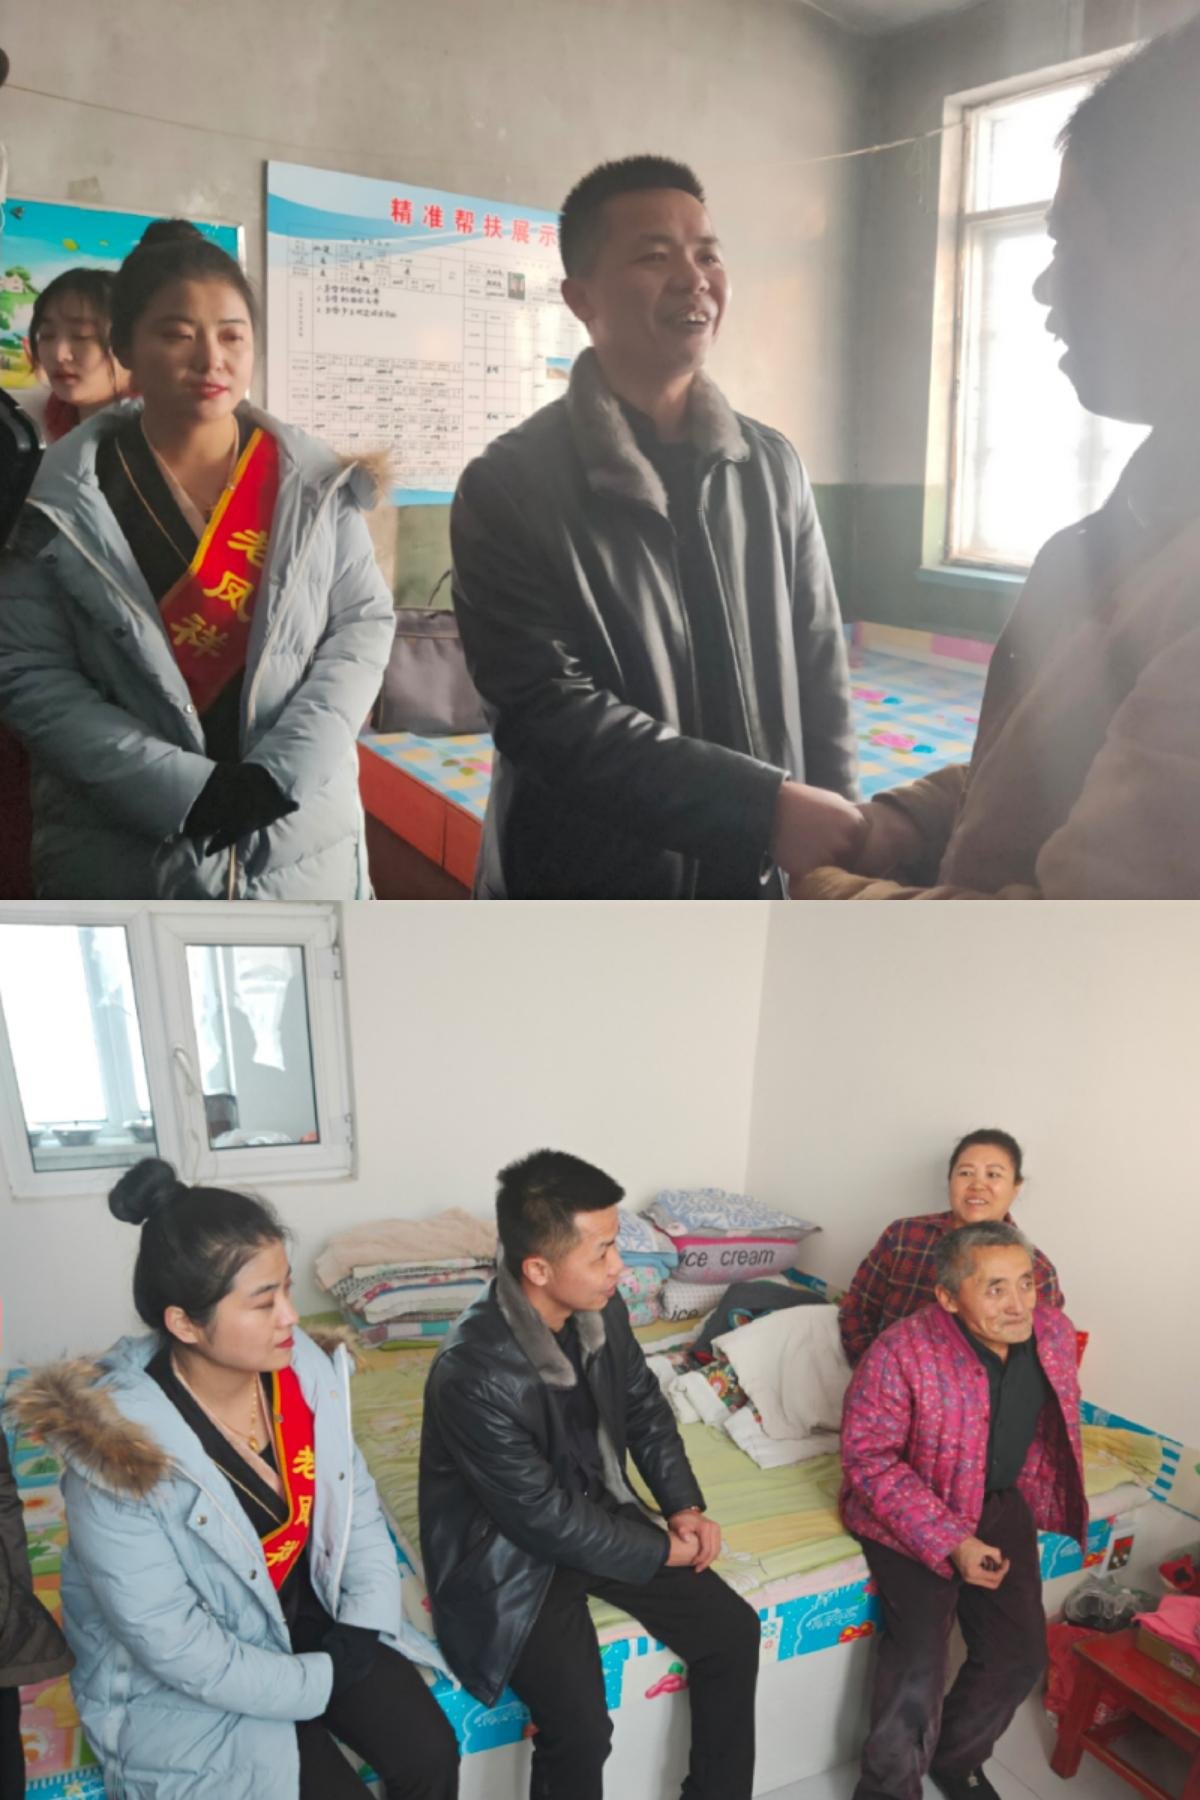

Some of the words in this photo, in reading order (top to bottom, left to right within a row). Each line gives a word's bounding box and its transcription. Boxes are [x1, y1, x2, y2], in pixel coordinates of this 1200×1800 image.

[389, 197, 558, 247] 精准帮扶展示
[170, 528, 270, 658] 老凤祥
[719, 1249, 775, 1267] cream
